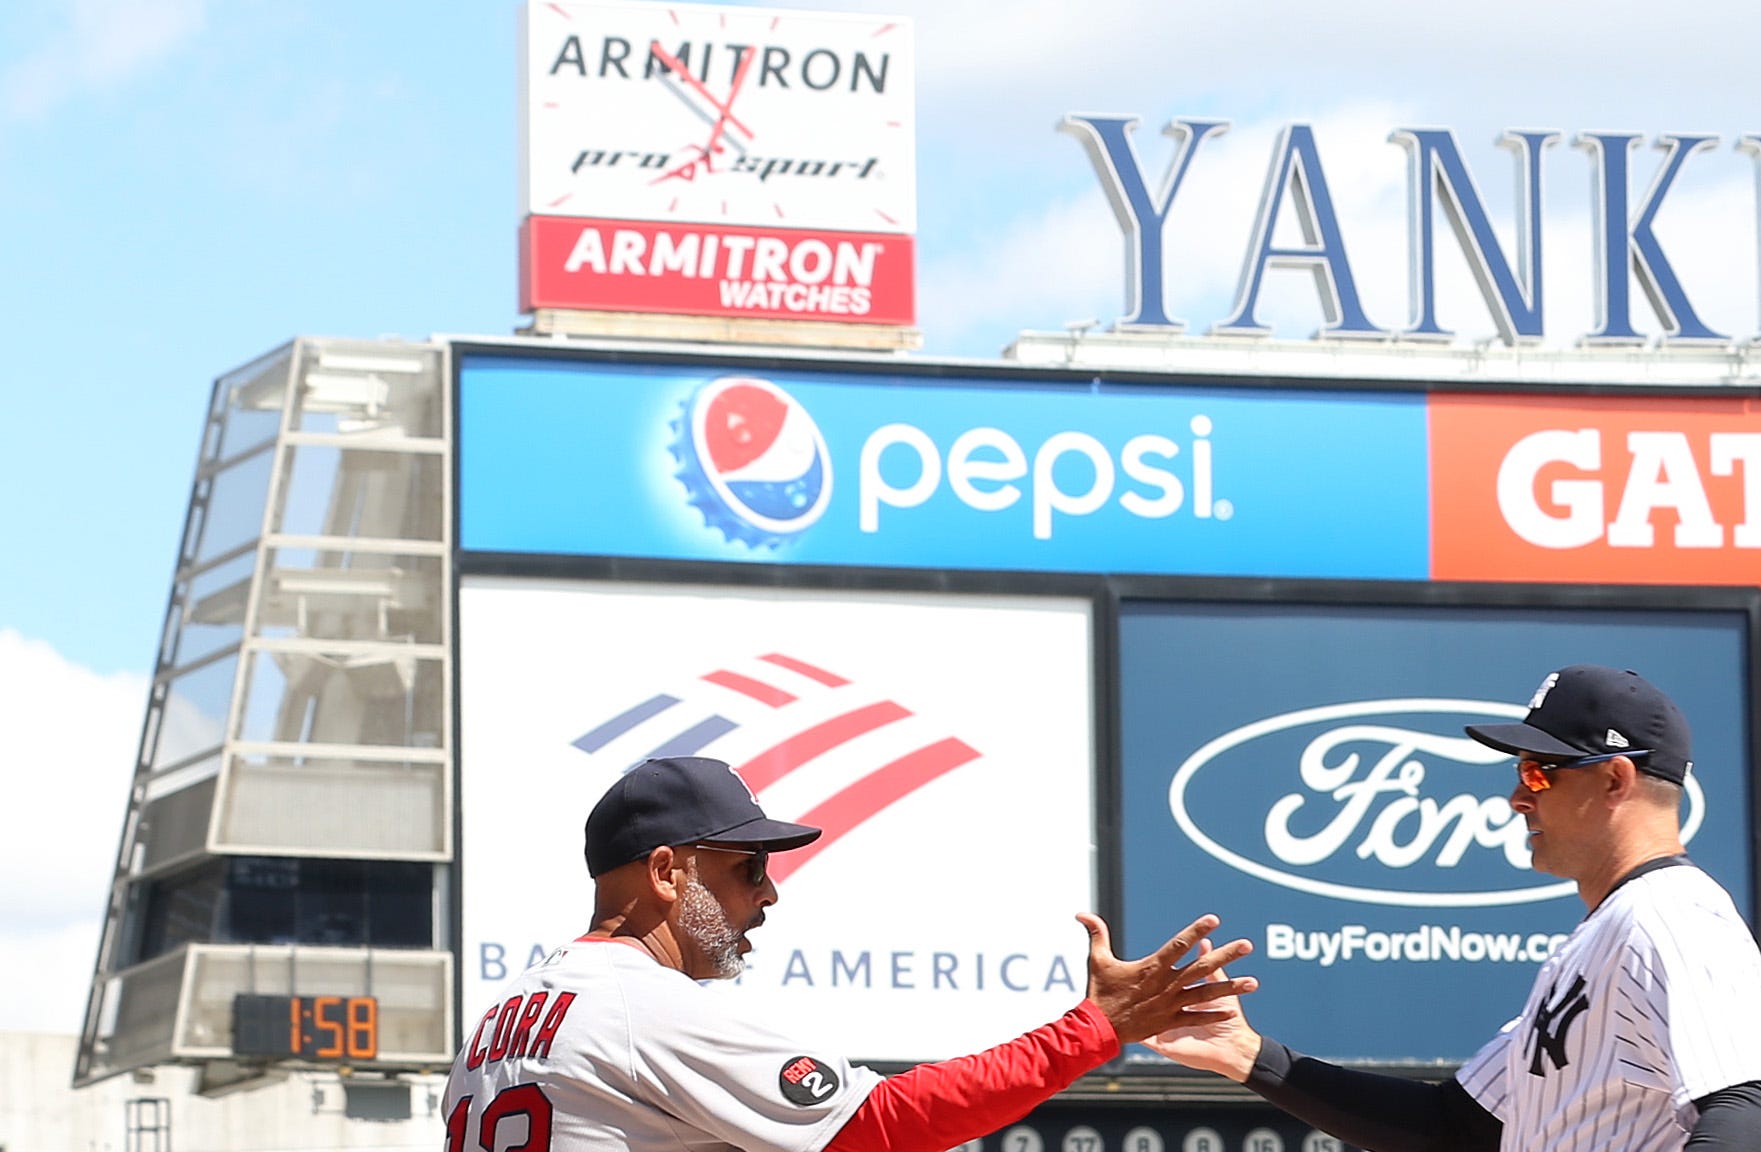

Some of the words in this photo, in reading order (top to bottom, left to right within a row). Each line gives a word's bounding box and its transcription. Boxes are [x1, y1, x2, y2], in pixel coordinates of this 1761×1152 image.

[549, 34, 890, 94] ARMITRON
[571, 148, 671, 174] pro
[732, 154, 879, 182] sport
[563, 228, 876, 287] ARMITRON
[719, 280, 872, 315] WATCHES
[860, 414, 1213, 540] pepsi
[781, 948, 1077, 993] AMERICA
[1266, 923, 1570, 966] BuyFordNow.co
[291, 996, 378, 1059] 1:58
[466, 991, 578, 1072] CORA
[801, 1071, 834, 1098] 2
